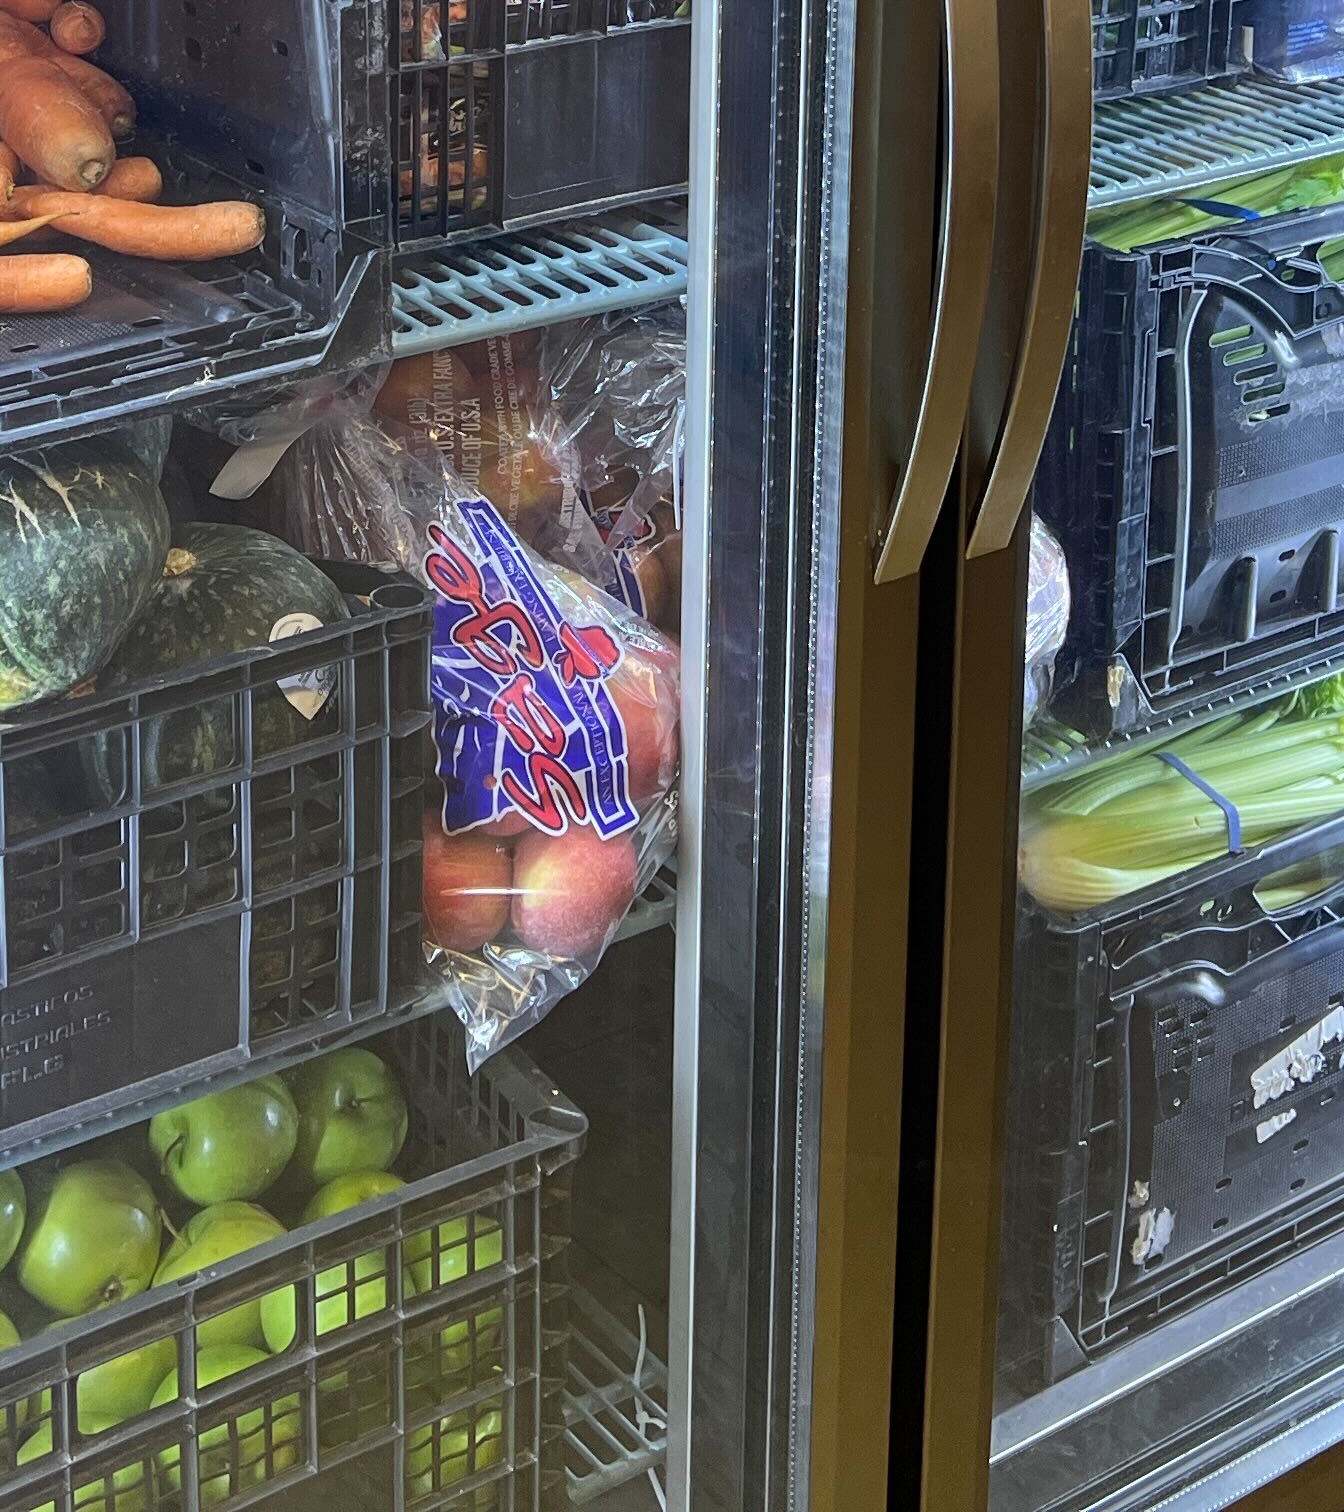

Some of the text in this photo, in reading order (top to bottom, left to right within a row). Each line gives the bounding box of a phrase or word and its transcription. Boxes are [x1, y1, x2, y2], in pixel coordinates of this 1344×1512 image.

[488, 353, 502, 381] GRADE
[433, 382, 454, 422] EXTRA
[493, 382, 505, 410] FOOD
[510, 410, 521, 423] DE
[460, 433, 481, 451] OF
[572, 691, 612, 785] EXCEPTIONAL
